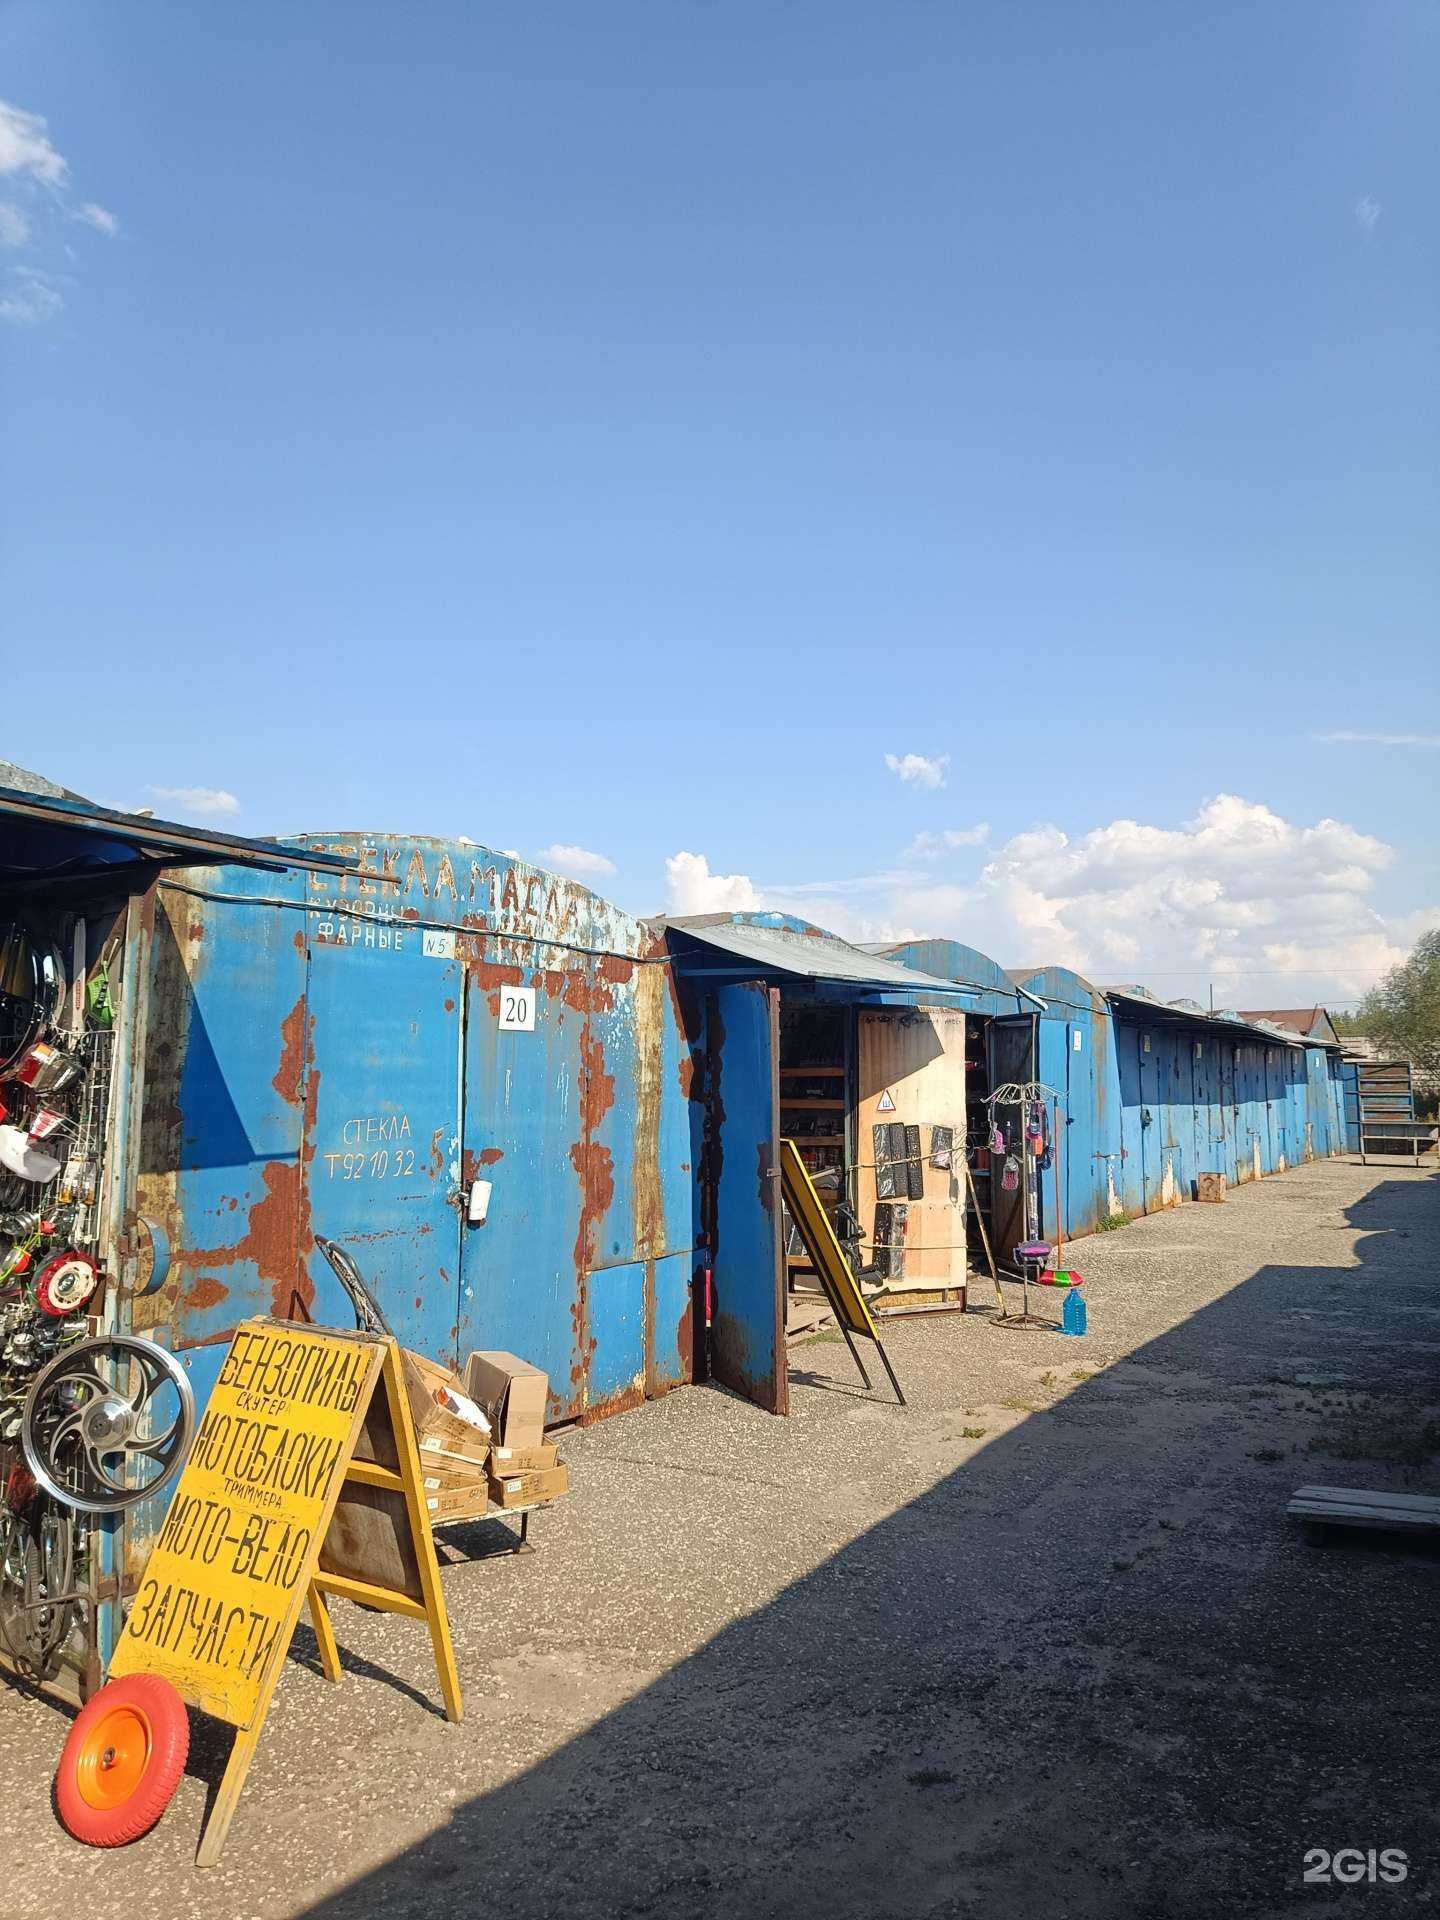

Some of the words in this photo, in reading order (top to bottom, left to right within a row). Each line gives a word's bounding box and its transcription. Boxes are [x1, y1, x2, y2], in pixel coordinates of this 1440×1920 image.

[318, 922, 402, 950] ФАРНЫЕ
[506, 998, 527, 1022] 20
[344, 1115, 411, 1144] СТЕКЛА
[218, 1331, 370, 1413] БЕНЗОПИЛЫ
[188, 1410, 344, 1501] МОТОБЛОКИ
[224, 1478, 282, 1510] ТРИММЕРА
[157, 1492, 311, 1590] МОТО-ВЕЛО
[128, 1579, 282, 1684] ЗАПЧАСТИ
